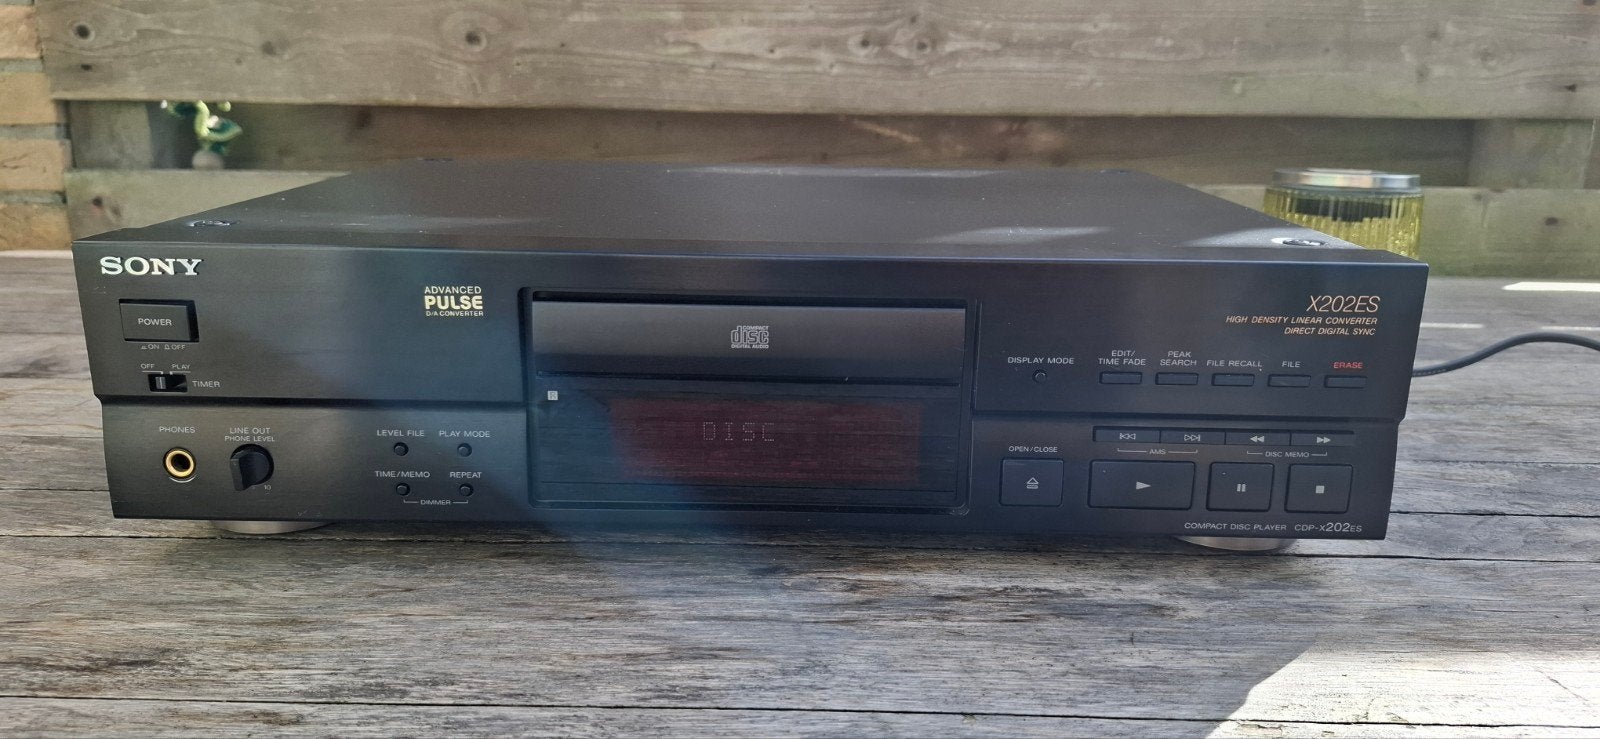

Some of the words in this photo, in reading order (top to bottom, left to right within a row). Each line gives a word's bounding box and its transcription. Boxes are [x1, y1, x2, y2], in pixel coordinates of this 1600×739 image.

[100, 256, 202, 276] SONY
[424, 286, 482, 294] ADVANCED
[424, 295, 484, 310] PULSE
[1306, 295, 1381, 313] X202ES
[137, 317, 173, 326] POWER
[1225, 315, 1249, 324] HIGH
[1251, 316, 1289, 324] DENSITY
[1290, 316, 1322, 325] LINEAR
[1325, 316, 1378, 326] CONVERTER
[1284, 326, 1315, 335] DIRECT
[1317, 327, 1350, 336] DIGITAL
[1352, 327, 1376, 336] SYNC
[1111, 349, 1136, 358] EDIT/
[1167, 350, 1192, 359] PEAK
[1007, 356, 1045, 365] DISPLAY
[1047, 357, 1075, 365] MODE
[1098, 357, 1120, 366] TIME
[1122, 358, 1147, 366] FADE
[1159, 358, 1198, 367] SEARCH
[1206, 359, 1226, 367] FILE
[1227, 359, 1263, 368] RECALL
[1281, 360, 1301, 368] FILE
[1333, 361, 1364, 369] ERASE
[192, 380, 221, 388] TIMER
[159, 426, 196, 434] PHONES
[229, 427, 250, 435] LINE
[252, 427, 271, 435] OUT
[376, 429, 404, 437] LEVEL
[438, 430, 461, 438] PLAY
[463, 430, 491, 438] MODE
[703, 421, 775, 442] DISC
[1008, 445, 1058, 453] OPEN/CLOSE
[374, 470, 431, 479] TIME/MEMO
[449, 471, 483, 479] REPEAT
[1184, 522, 1227, 530] COMPACT
[1230, 523, 1251, 531] DISC
[1253, 523, 1287, 532] PLAYER
